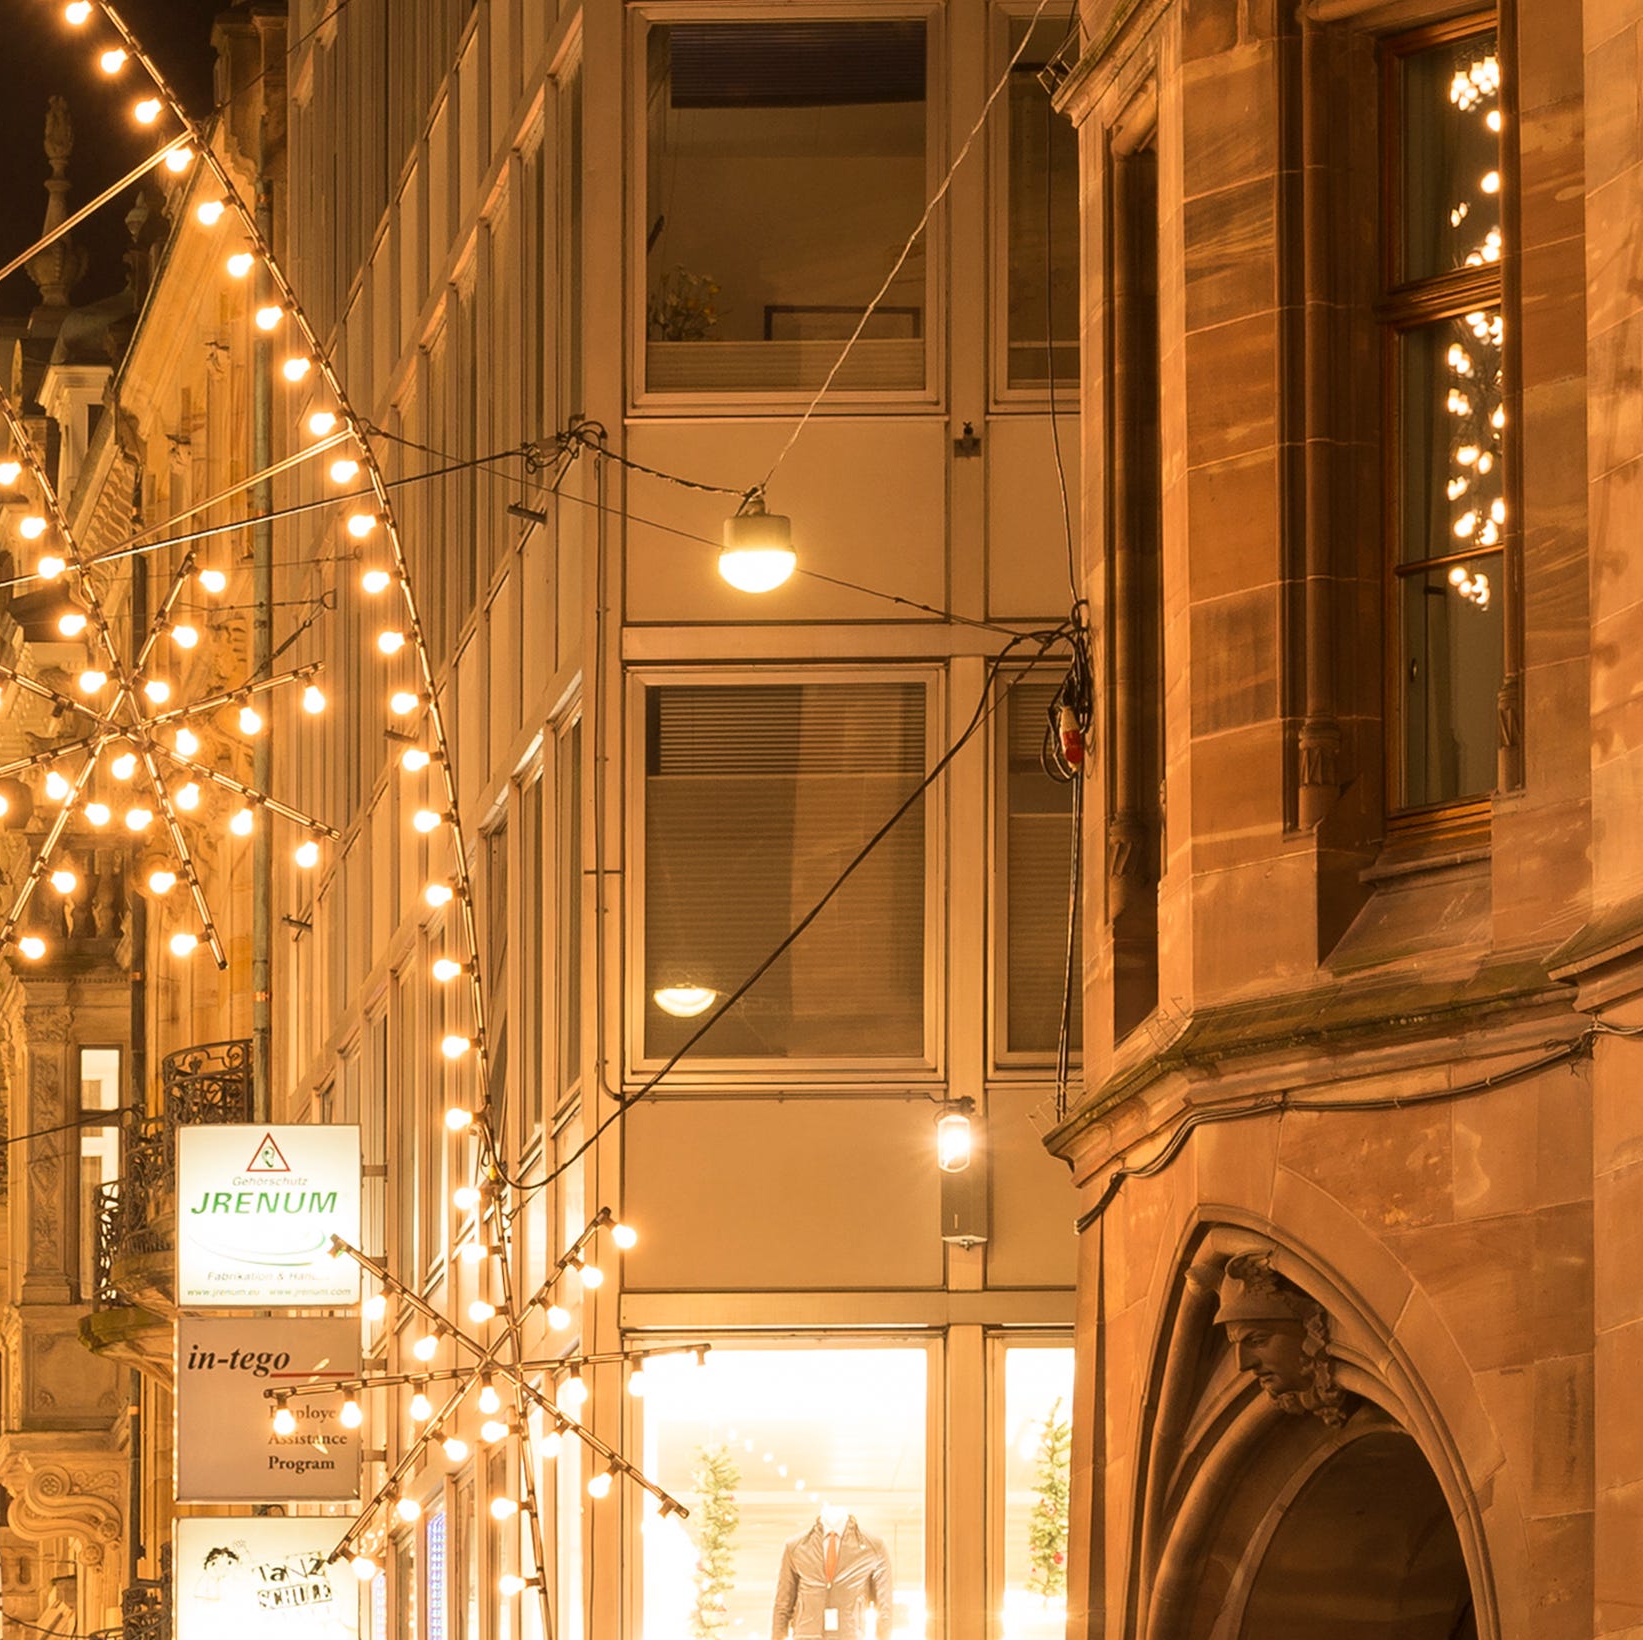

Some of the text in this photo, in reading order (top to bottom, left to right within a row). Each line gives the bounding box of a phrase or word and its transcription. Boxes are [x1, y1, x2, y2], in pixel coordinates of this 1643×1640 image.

[191, 1191, 338, 1214] JRENUM
[187, 1344, 291, 1377] in-tego
[268, 1455, 335, 1474] Program
